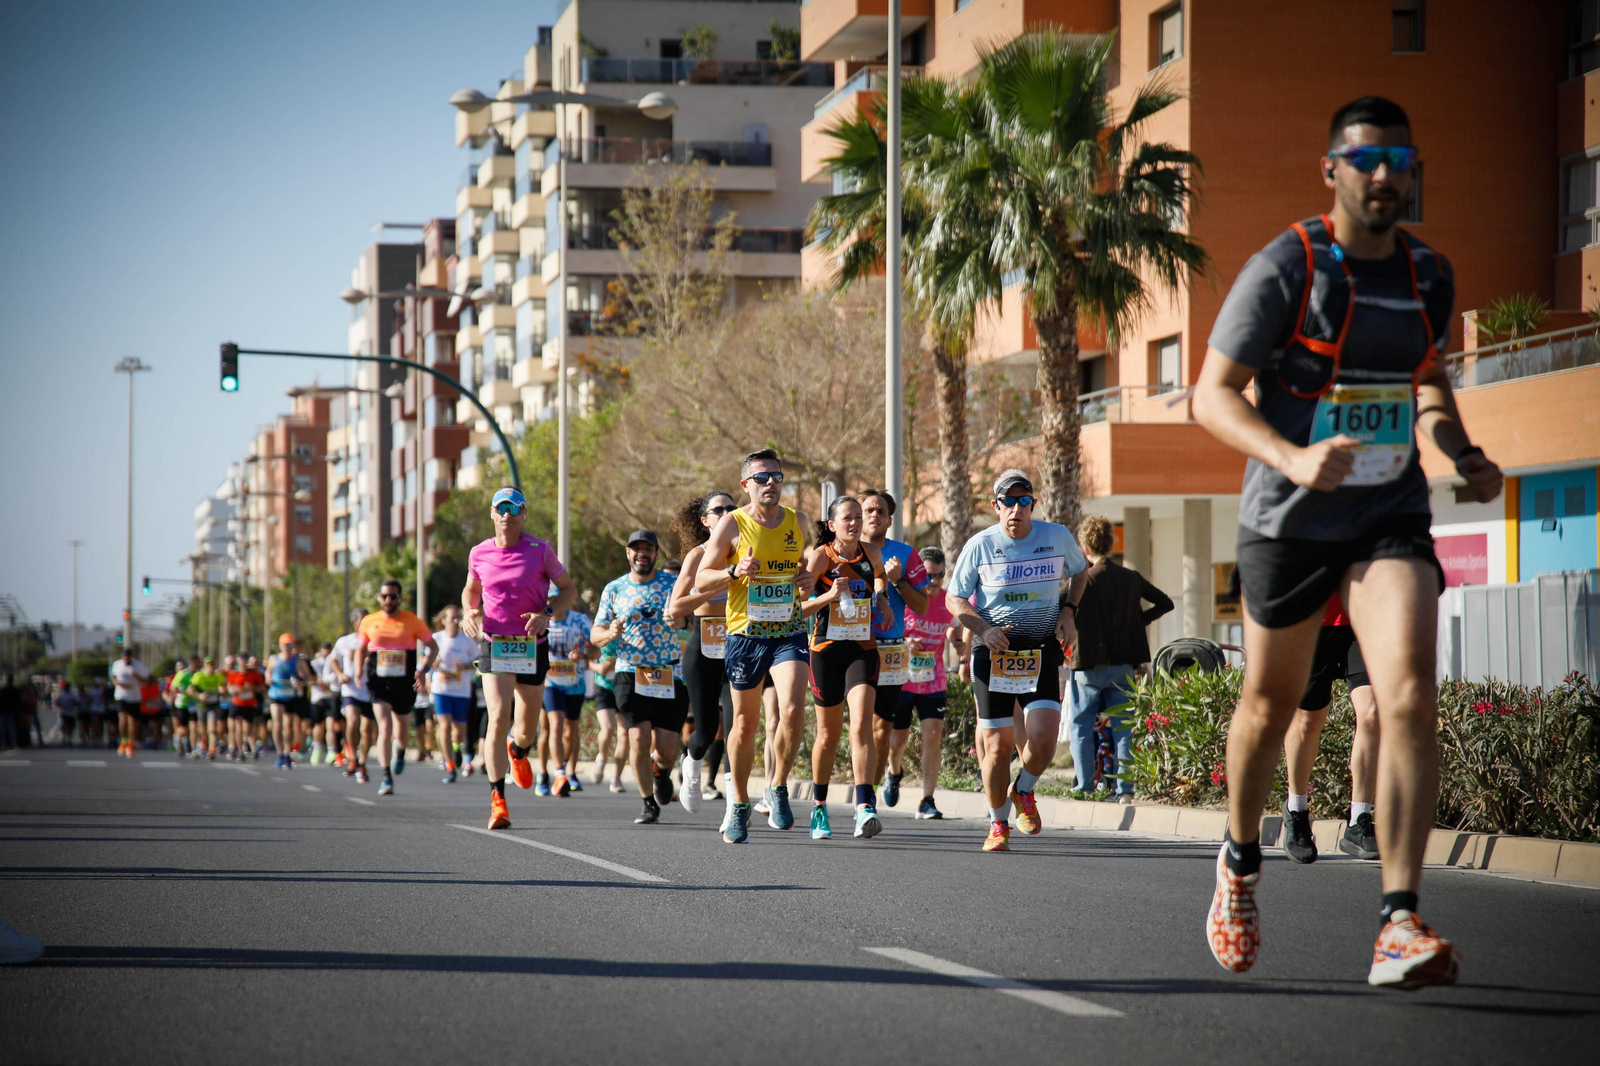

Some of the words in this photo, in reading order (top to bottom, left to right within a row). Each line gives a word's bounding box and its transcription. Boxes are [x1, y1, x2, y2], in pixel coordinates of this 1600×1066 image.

[1326, 402, 1399, 432] 1601
[755, 584, 791, 598] 1064
[835, 605, 868, 618] 115
[501, 642, 527, 653] 329
[910, 657, 931, 666] 476
[996, 657, 1036, 670] 1292
